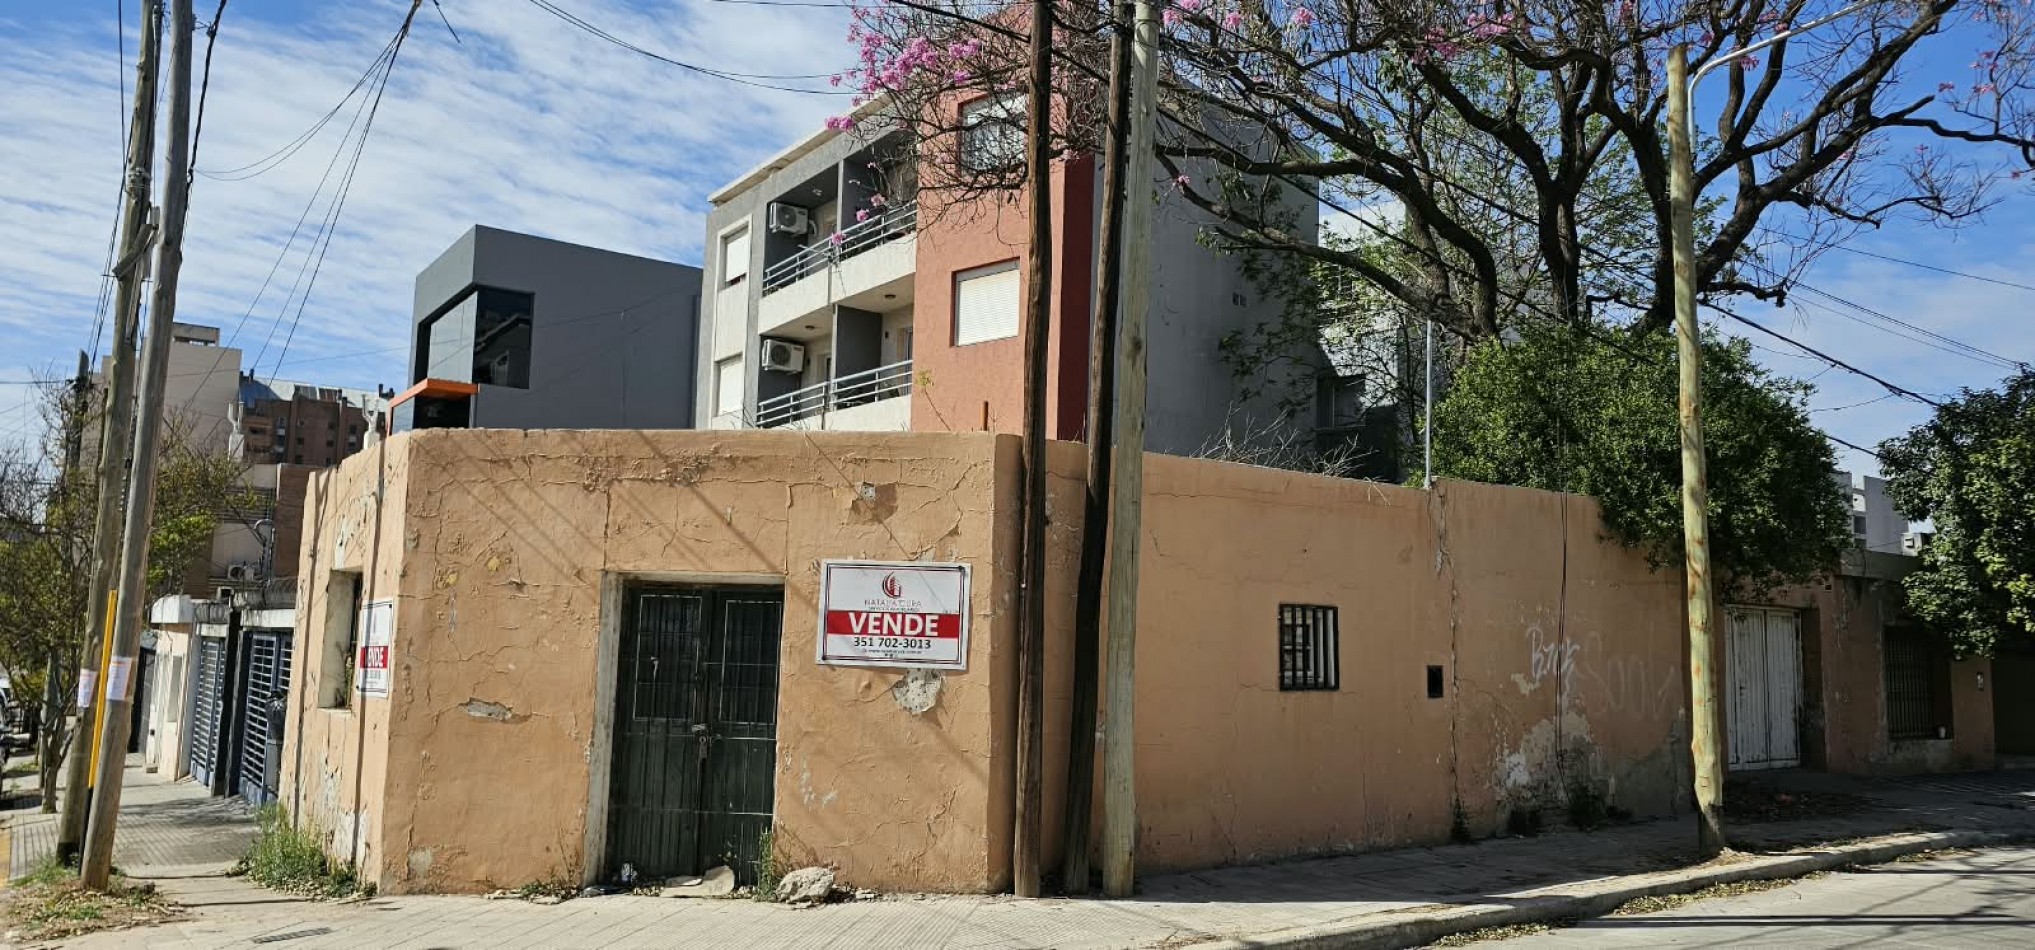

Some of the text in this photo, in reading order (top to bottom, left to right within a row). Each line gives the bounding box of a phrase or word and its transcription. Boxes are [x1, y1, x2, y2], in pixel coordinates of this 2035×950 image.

[848, 612, 939, 637] VENDE
[854, 636, 931, 649] 351 702-3013
